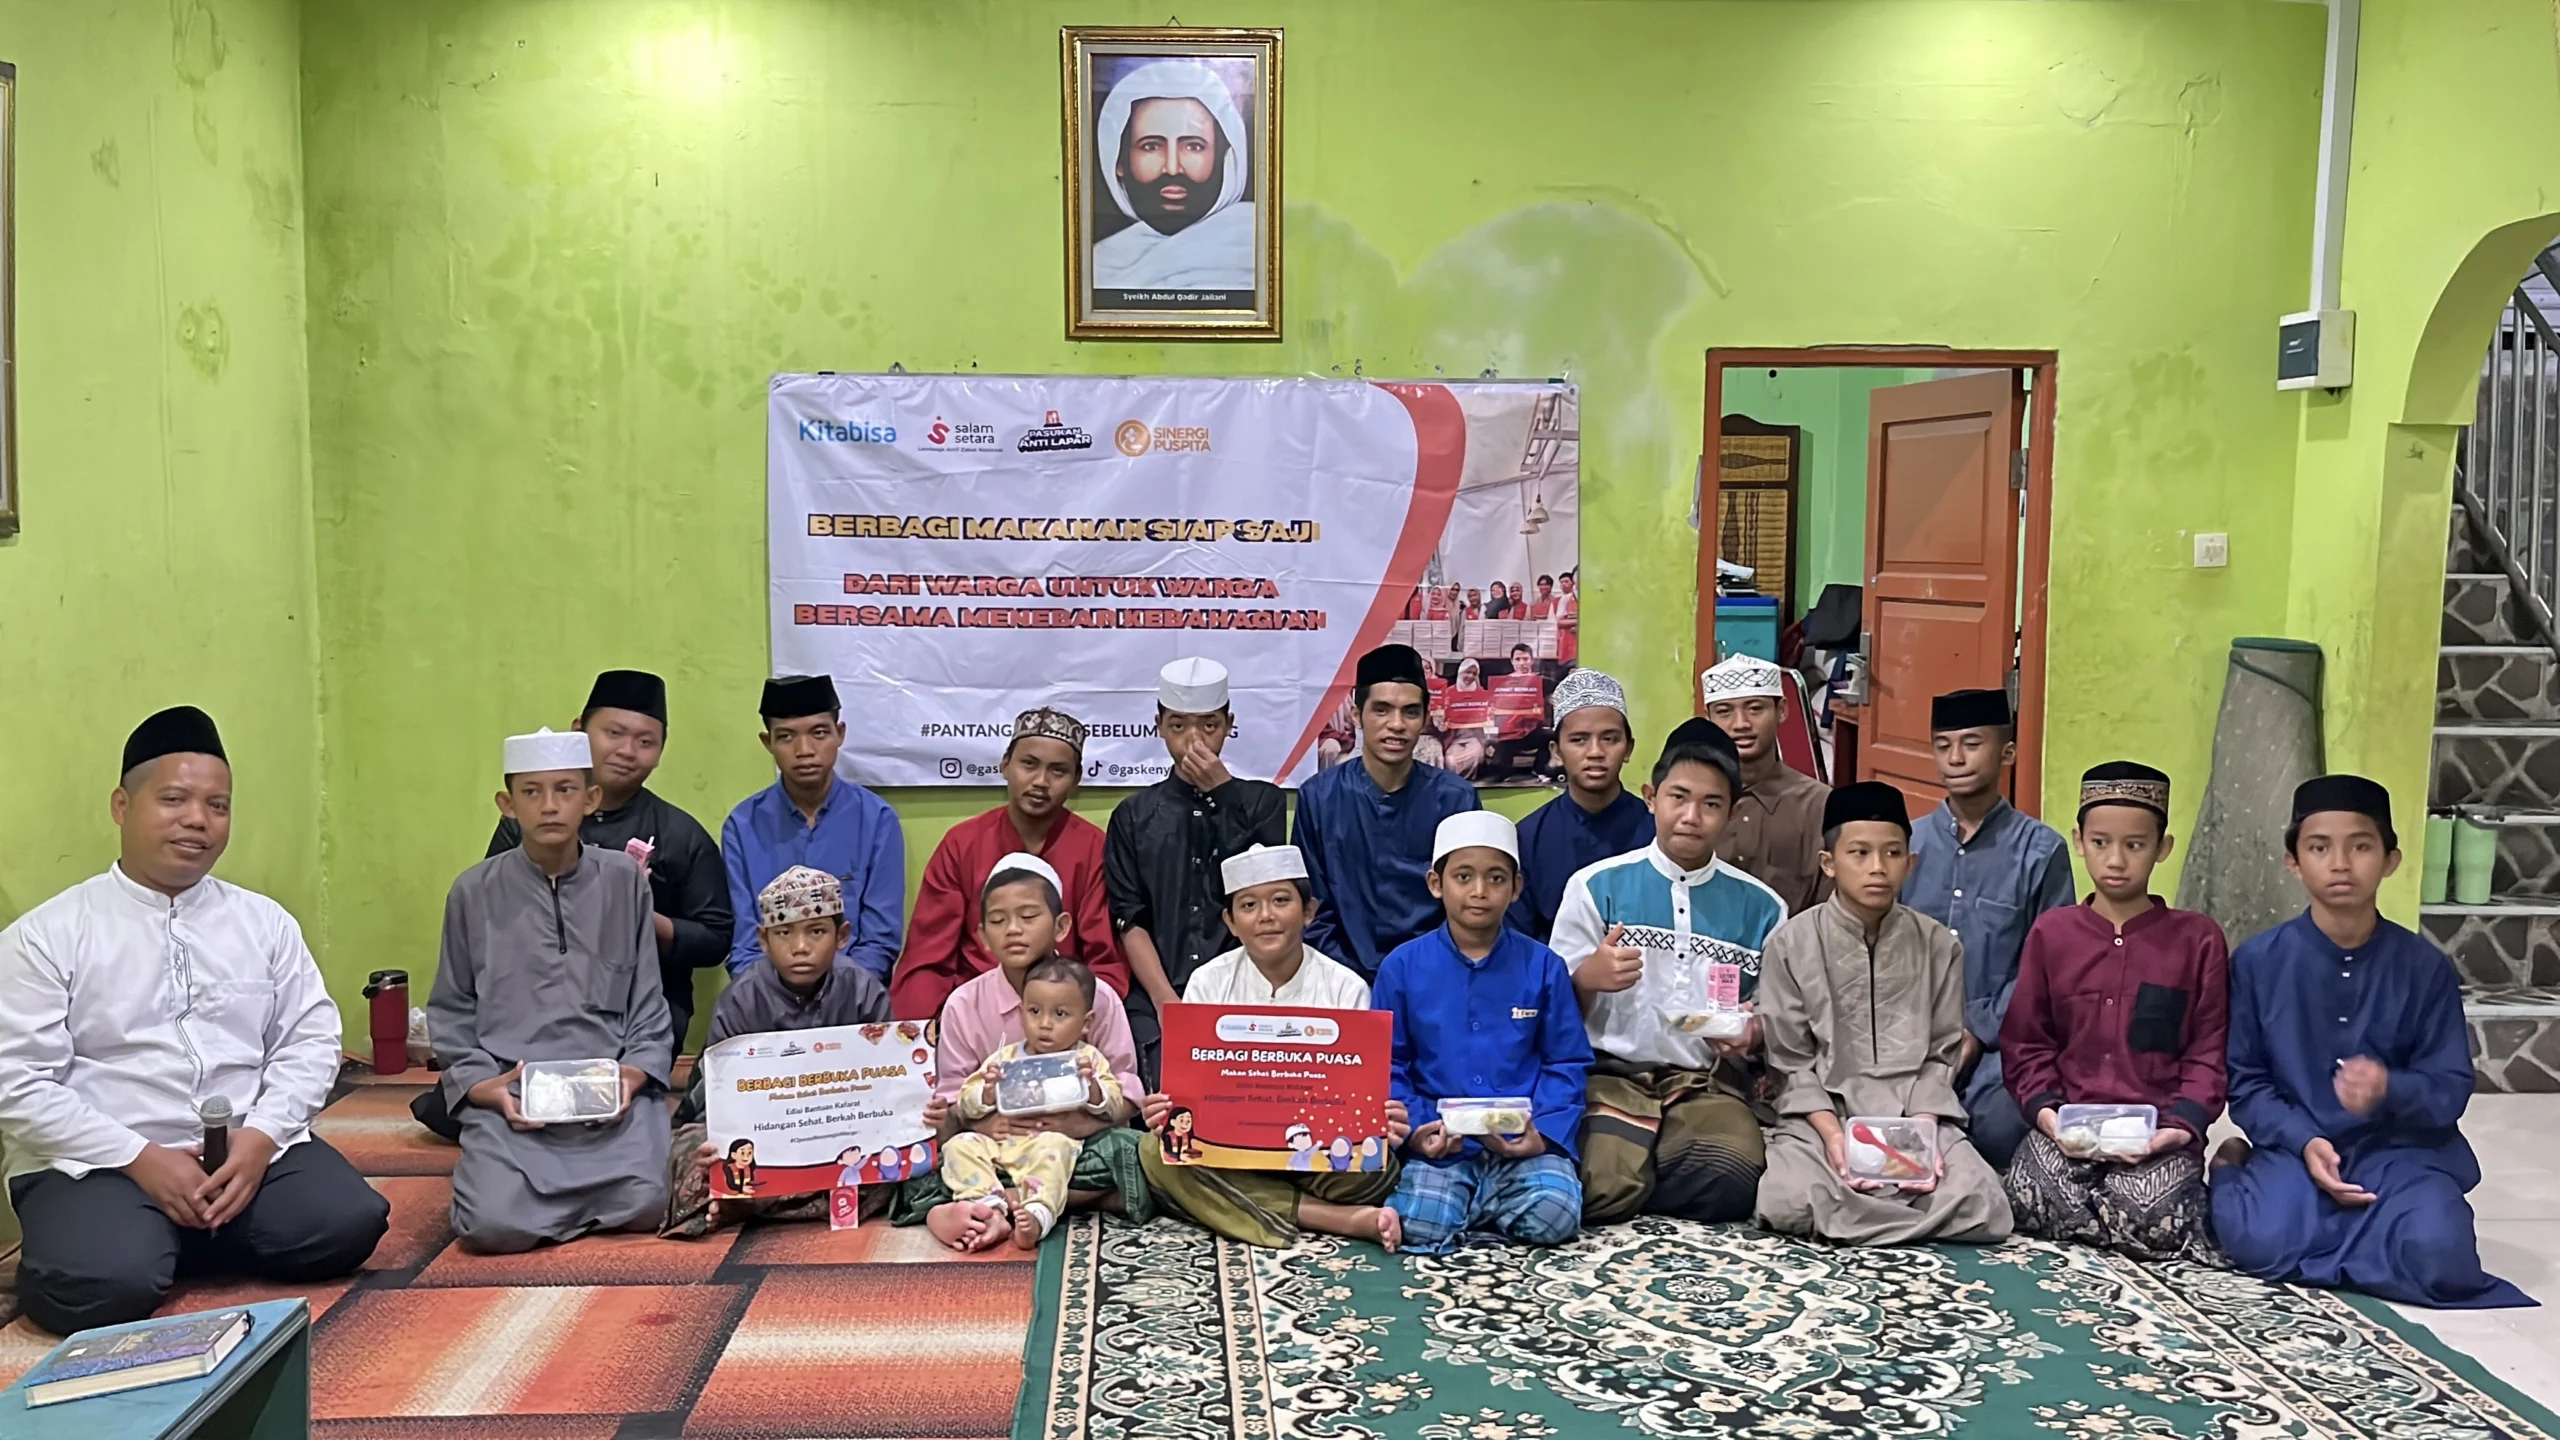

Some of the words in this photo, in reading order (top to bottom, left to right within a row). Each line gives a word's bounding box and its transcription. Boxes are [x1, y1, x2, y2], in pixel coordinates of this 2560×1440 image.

[1123, 293, 1149, 301] Syeikh
[800, 420, 897, 443] Kitabisa
[955, 423, 994, 433] salam
[1029, 428, 1082, 438] PASUKAN
[1153, 427, 1209, 440] SINERGI
[955, 434, 995, 444] setara
[1019, 437, 1049, 449] ANTI
[1050, 435, 1092, 448] LAPAR
[1153, 440, 1211, 452] PUSPITA
[808, 514, 959, 539] BERBAGI
[963, 517, 1146, 541] MAKANAN
[1146, 519, 1236, 542] SIAP
[1236, 519, 1321, 542] SAJI
[844, 574, 922, 595] DARI
[923, 575, 1044, 597] WARGA
[1046, 577, 1158, 598] UNTUK
[1159, 577, 1280, 598] WARGA
[794, 604, 956, 627] BERSAMA
[958, 607, 1116, 629] MENEBAR
[1116, 608, 1327, 630] KEBAHAGIAN
[1108, 763, 1171, 777] @gaskeny
[1191, 1047, 1249, 1062] BERBAGI
[1251, 1049, 1313, 1064] BERBUKA
[1316, 1052, 1362, 1066] PUASA
[737, 1076, 796, 1093] BERBAGI
[798, 1069, 860, 1088] BERBUKA
[861, 1064, 908, 1080] PUASA
[1221, 1069, 1247, 1077] Makan
[786, 1107, 803, 1116] Edisi
[804, 1103, 834, 1114] Bantuan
[835, 1100, 861, 1109] Kafarat
[754, 1119, 797, 1132] Hidangan
[826, 1113, 856, 1124] Berkah
[858, 1108, 894, 1120] Berbuka
